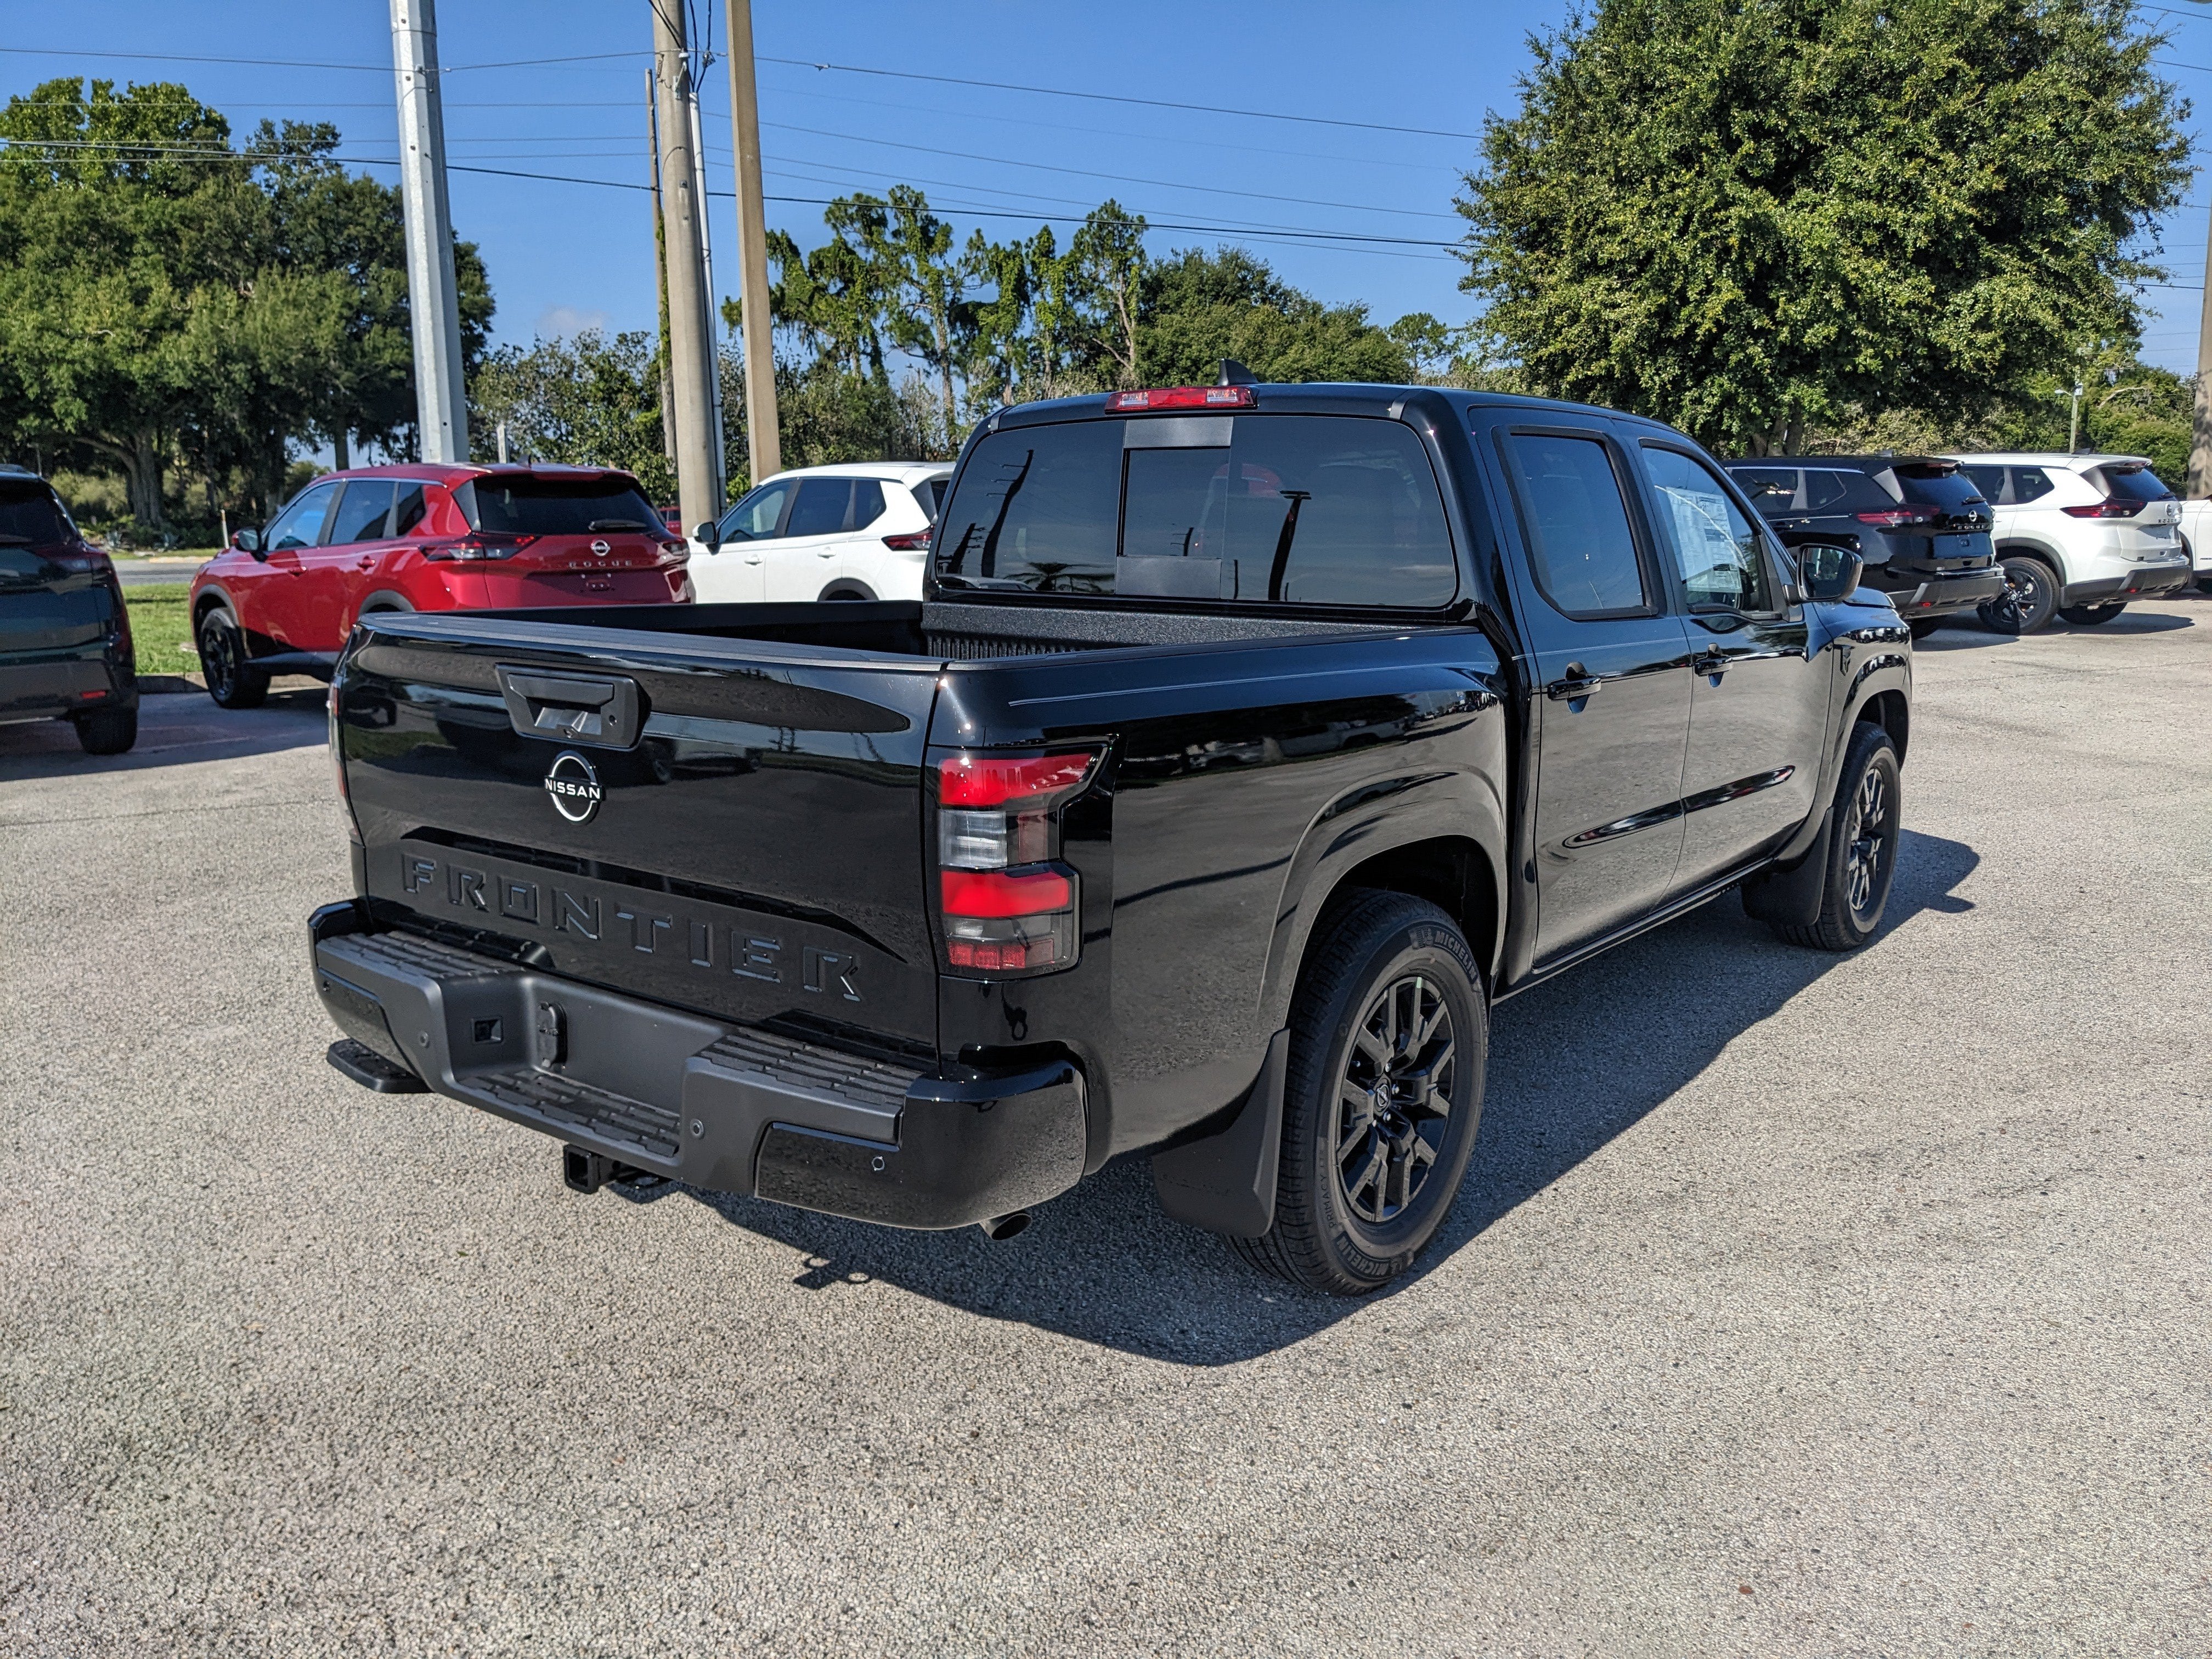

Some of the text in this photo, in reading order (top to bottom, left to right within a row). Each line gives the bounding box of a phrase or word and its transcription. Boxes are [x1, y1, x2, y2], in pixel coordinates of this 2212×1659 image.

[569, 560, 632, 568] ROGUE
[545, 778, 600, 799] NISSAN
[400, 853, 862, 1002] FRONTIER
[1435, 931, 1477, 980] MICHELIN
[1319, 1173, 1337, 1228] PRIMACY
[1336, 1235, 1389, 1276] MICHELIN
